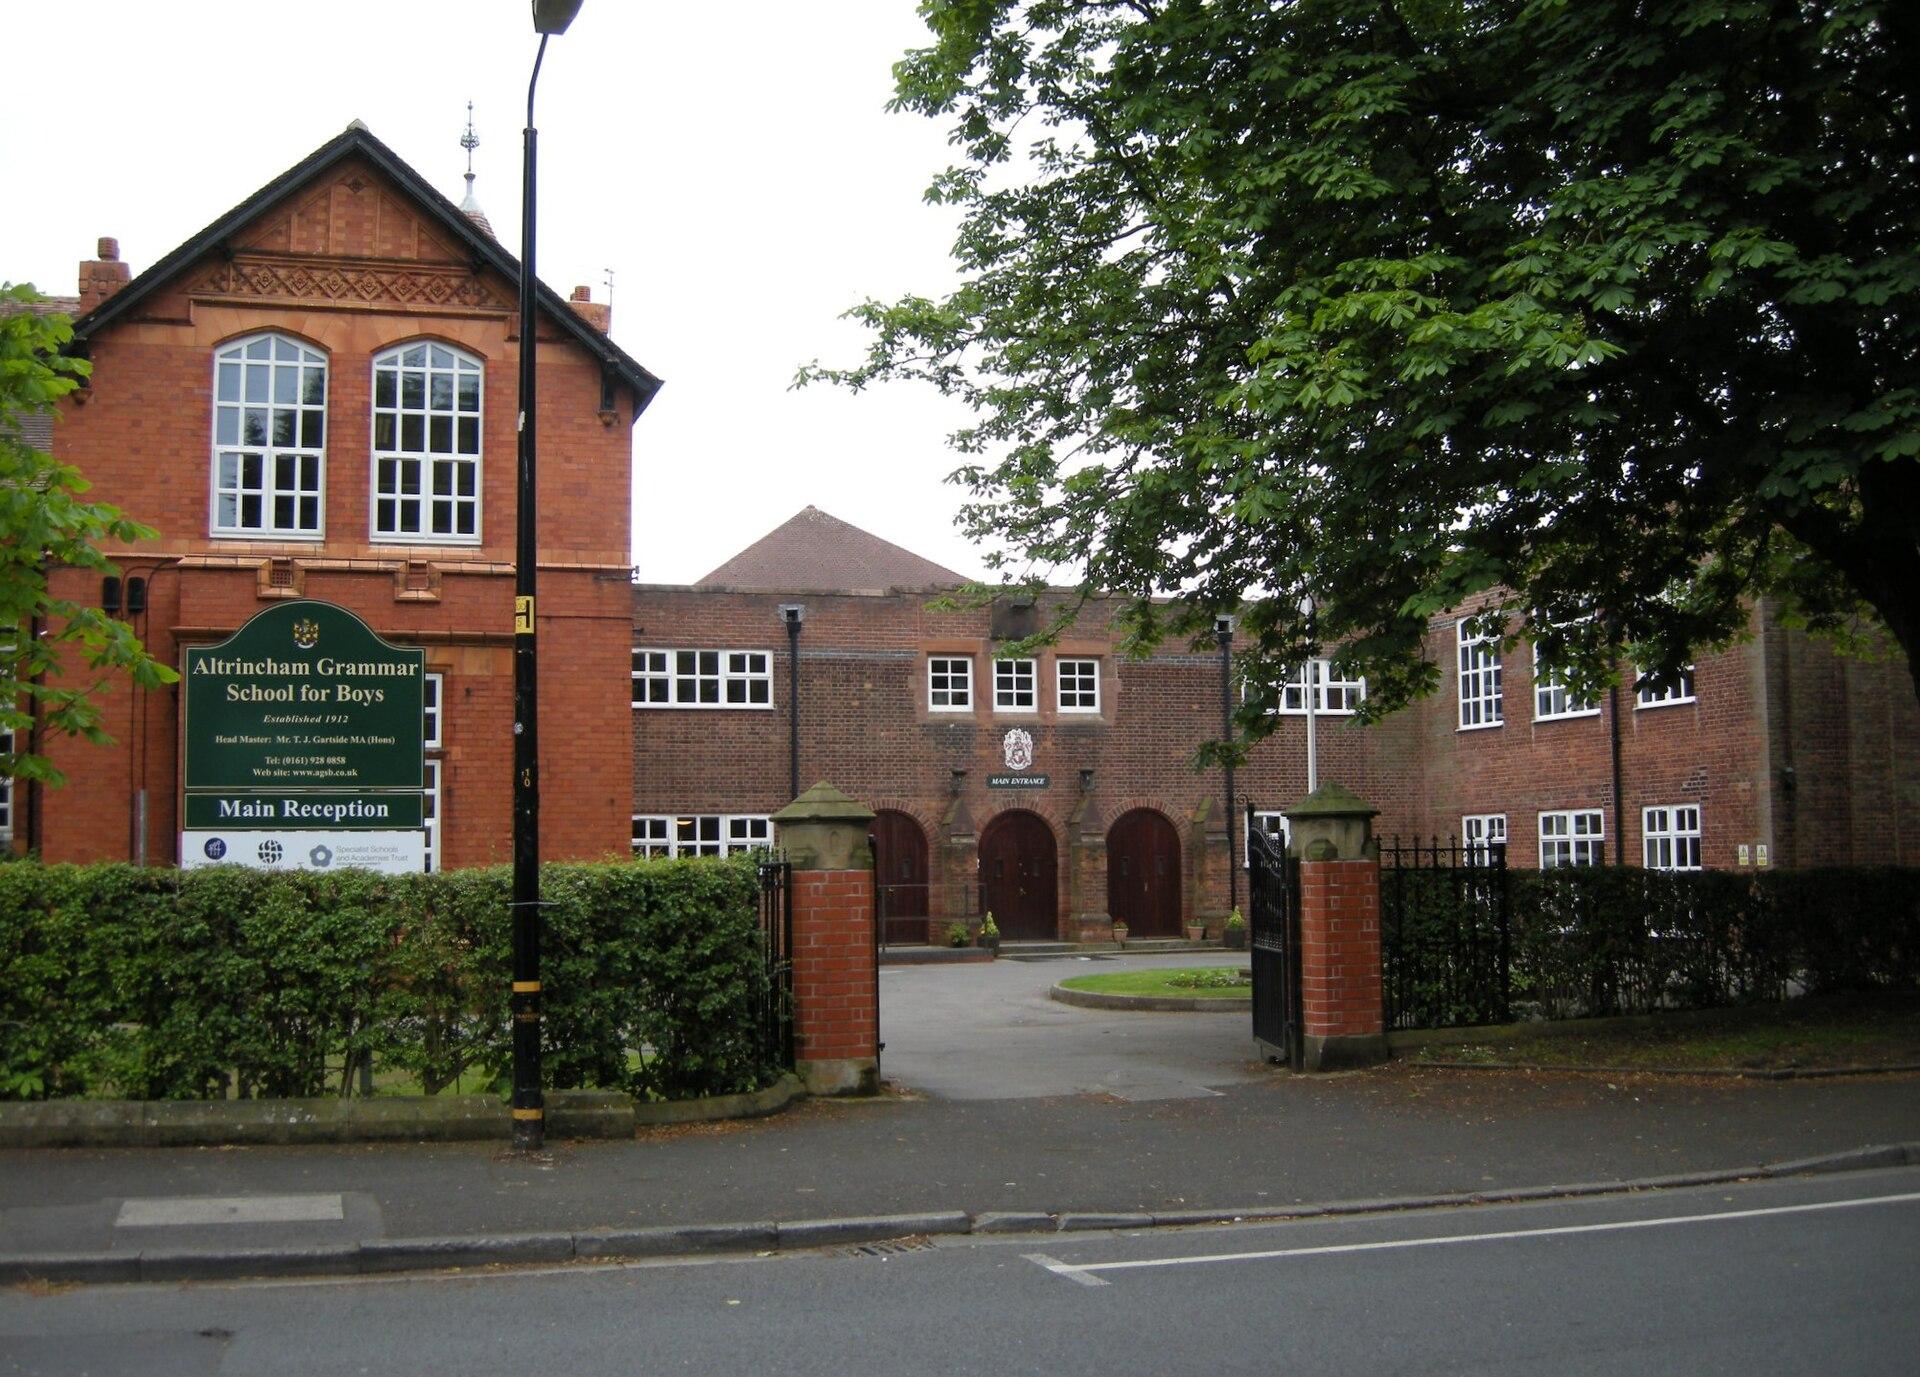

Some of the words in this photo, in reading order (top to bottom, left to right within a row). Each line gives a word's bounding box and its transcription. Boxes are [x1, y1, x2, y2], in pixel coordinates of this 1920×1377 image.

[192, 657, 310, 676] Altrincham
[316, 657, 419, 676] Grammar
[226, 683, 294, 702] School
[300, 683, 331, 702] for
[336, 684, 385, 706] Boys
[263, 714, 322, 723] Established
[325, 715, 349, 723] 1912
[215, 735, 238, 744] Head
[239, 735, 272, 744] Master:
[276, 735, 291, 744] Mr.
[293, 735, 302, 744] T.
[303, 735, 311, 744] J.
[312, 735, 349, 744] Gartside
[350, 735, 366, 744] MA
[367, 735, 396, 746] (Hons)
[264, 756, 281, 765] Tel:
[282, 756, 309, 766] (0161)
[309, 756, 325, 765] 928
[252, 768, 272, 777] Web
[273, 768, 291, 777] site:
[292, 768, 358, 779] www.agsb.co.uk
[219, 799, 275, 818] Main
[283, 799, 389, 822] Reception
